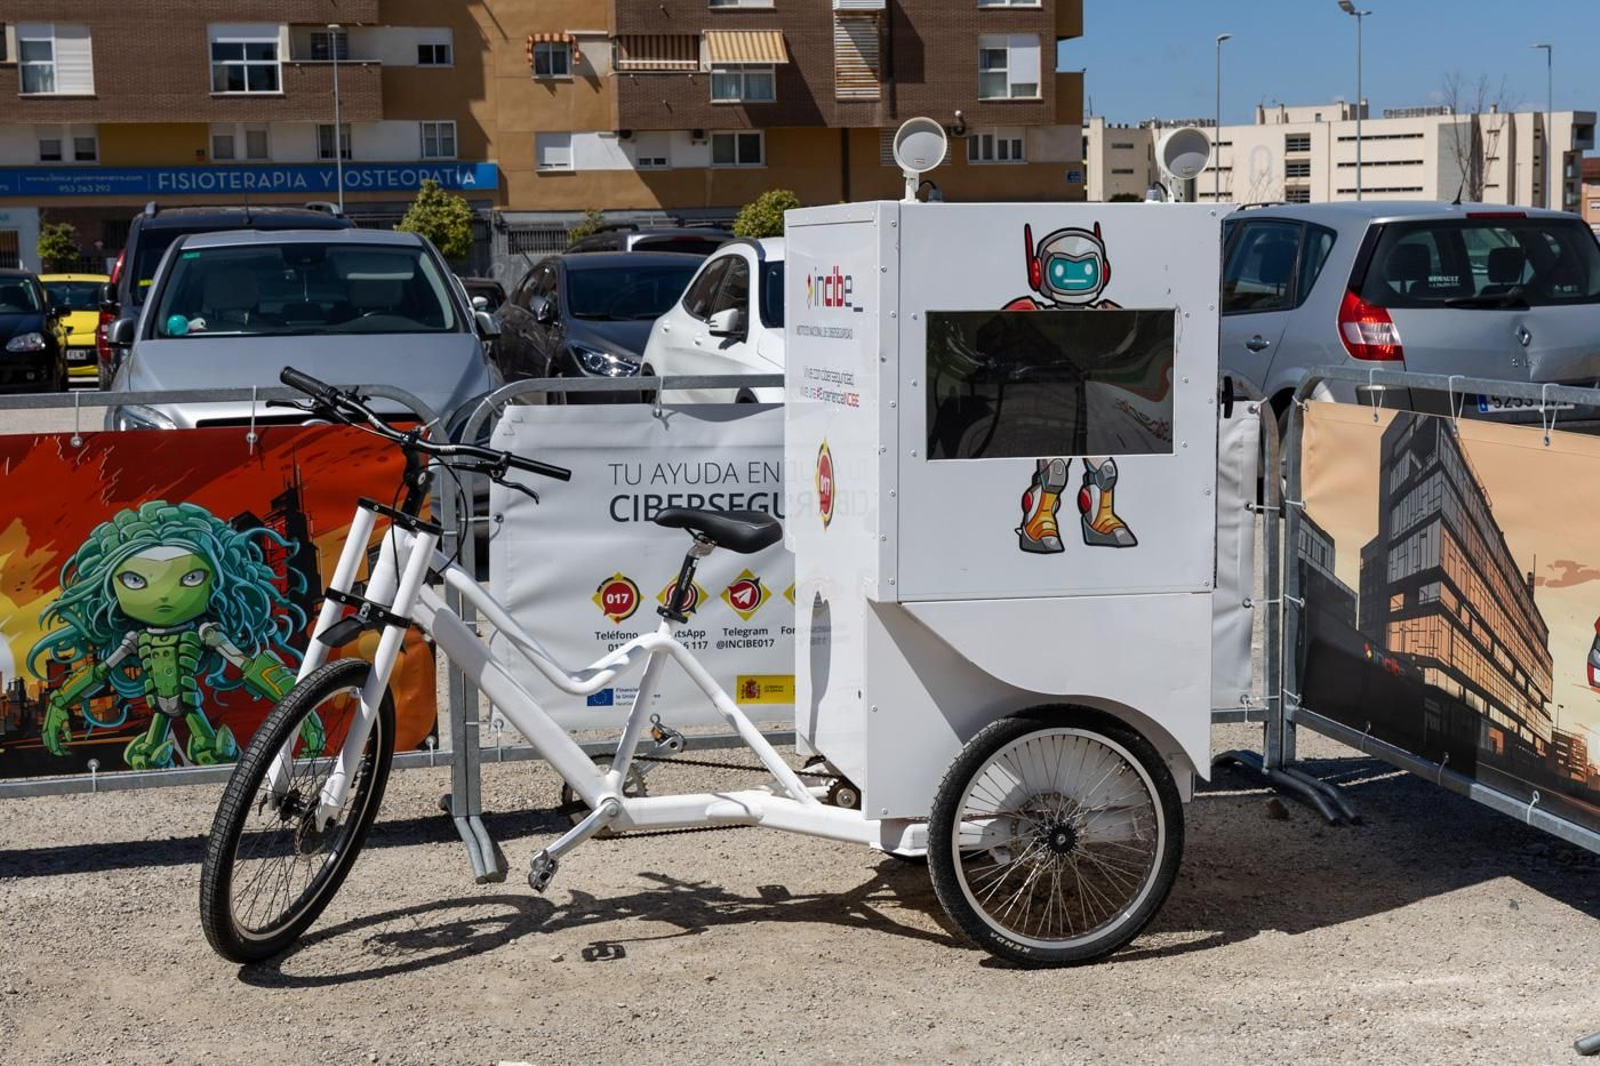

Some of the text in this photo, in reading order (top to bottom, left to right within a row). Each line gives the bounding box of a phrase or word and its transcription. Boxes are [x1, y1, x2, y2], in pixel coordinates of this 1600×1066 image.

[157, 171, 307, 190] FISIOTERAPIA
[319, 171, 333, 187] Y
[608, 461, 780, 486] TU AYUDA EN
[606, 593, 630, 605] 017
[595, 631, 639, 641] Teléfono
[655, 629, 706, 640] tsApp
[722, 627, 769, 638] Telegram
[608, 643, 625, 653] 01
[693, 641, 709, 650] 117
[716, 638, 775, 650] @INCIBE017
[990, 931, 1031, 953] KENDA
